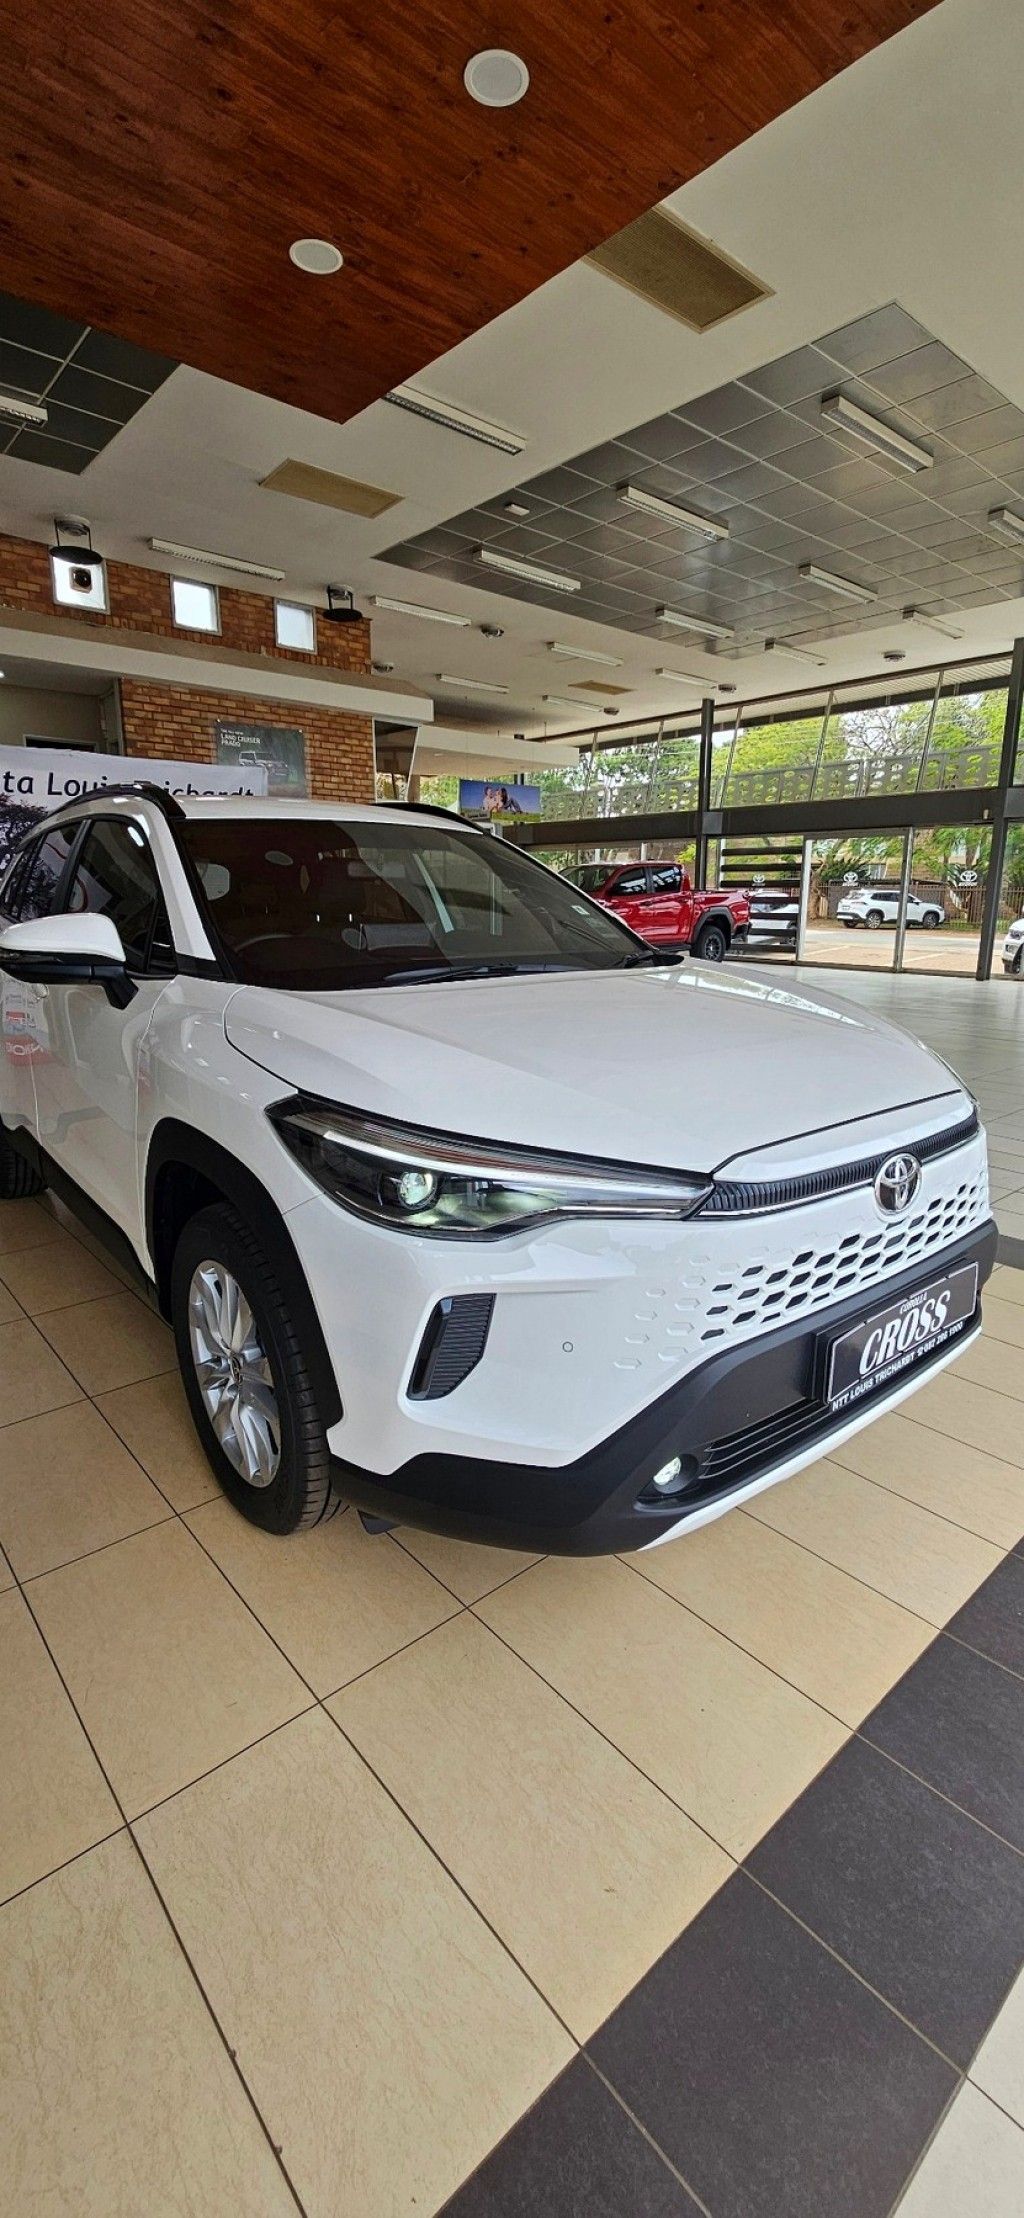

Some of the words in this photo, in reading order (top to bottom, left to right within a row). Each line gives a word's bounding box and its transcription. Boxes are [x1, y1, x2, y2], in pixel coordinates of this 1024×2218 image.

[47, 772, 108, 797] Lou
[859, 1289, 951, 1375] CROSS
[832, 1393, 850, 1412] NTT
[849, 1377, 874, 1400] LOUIS
